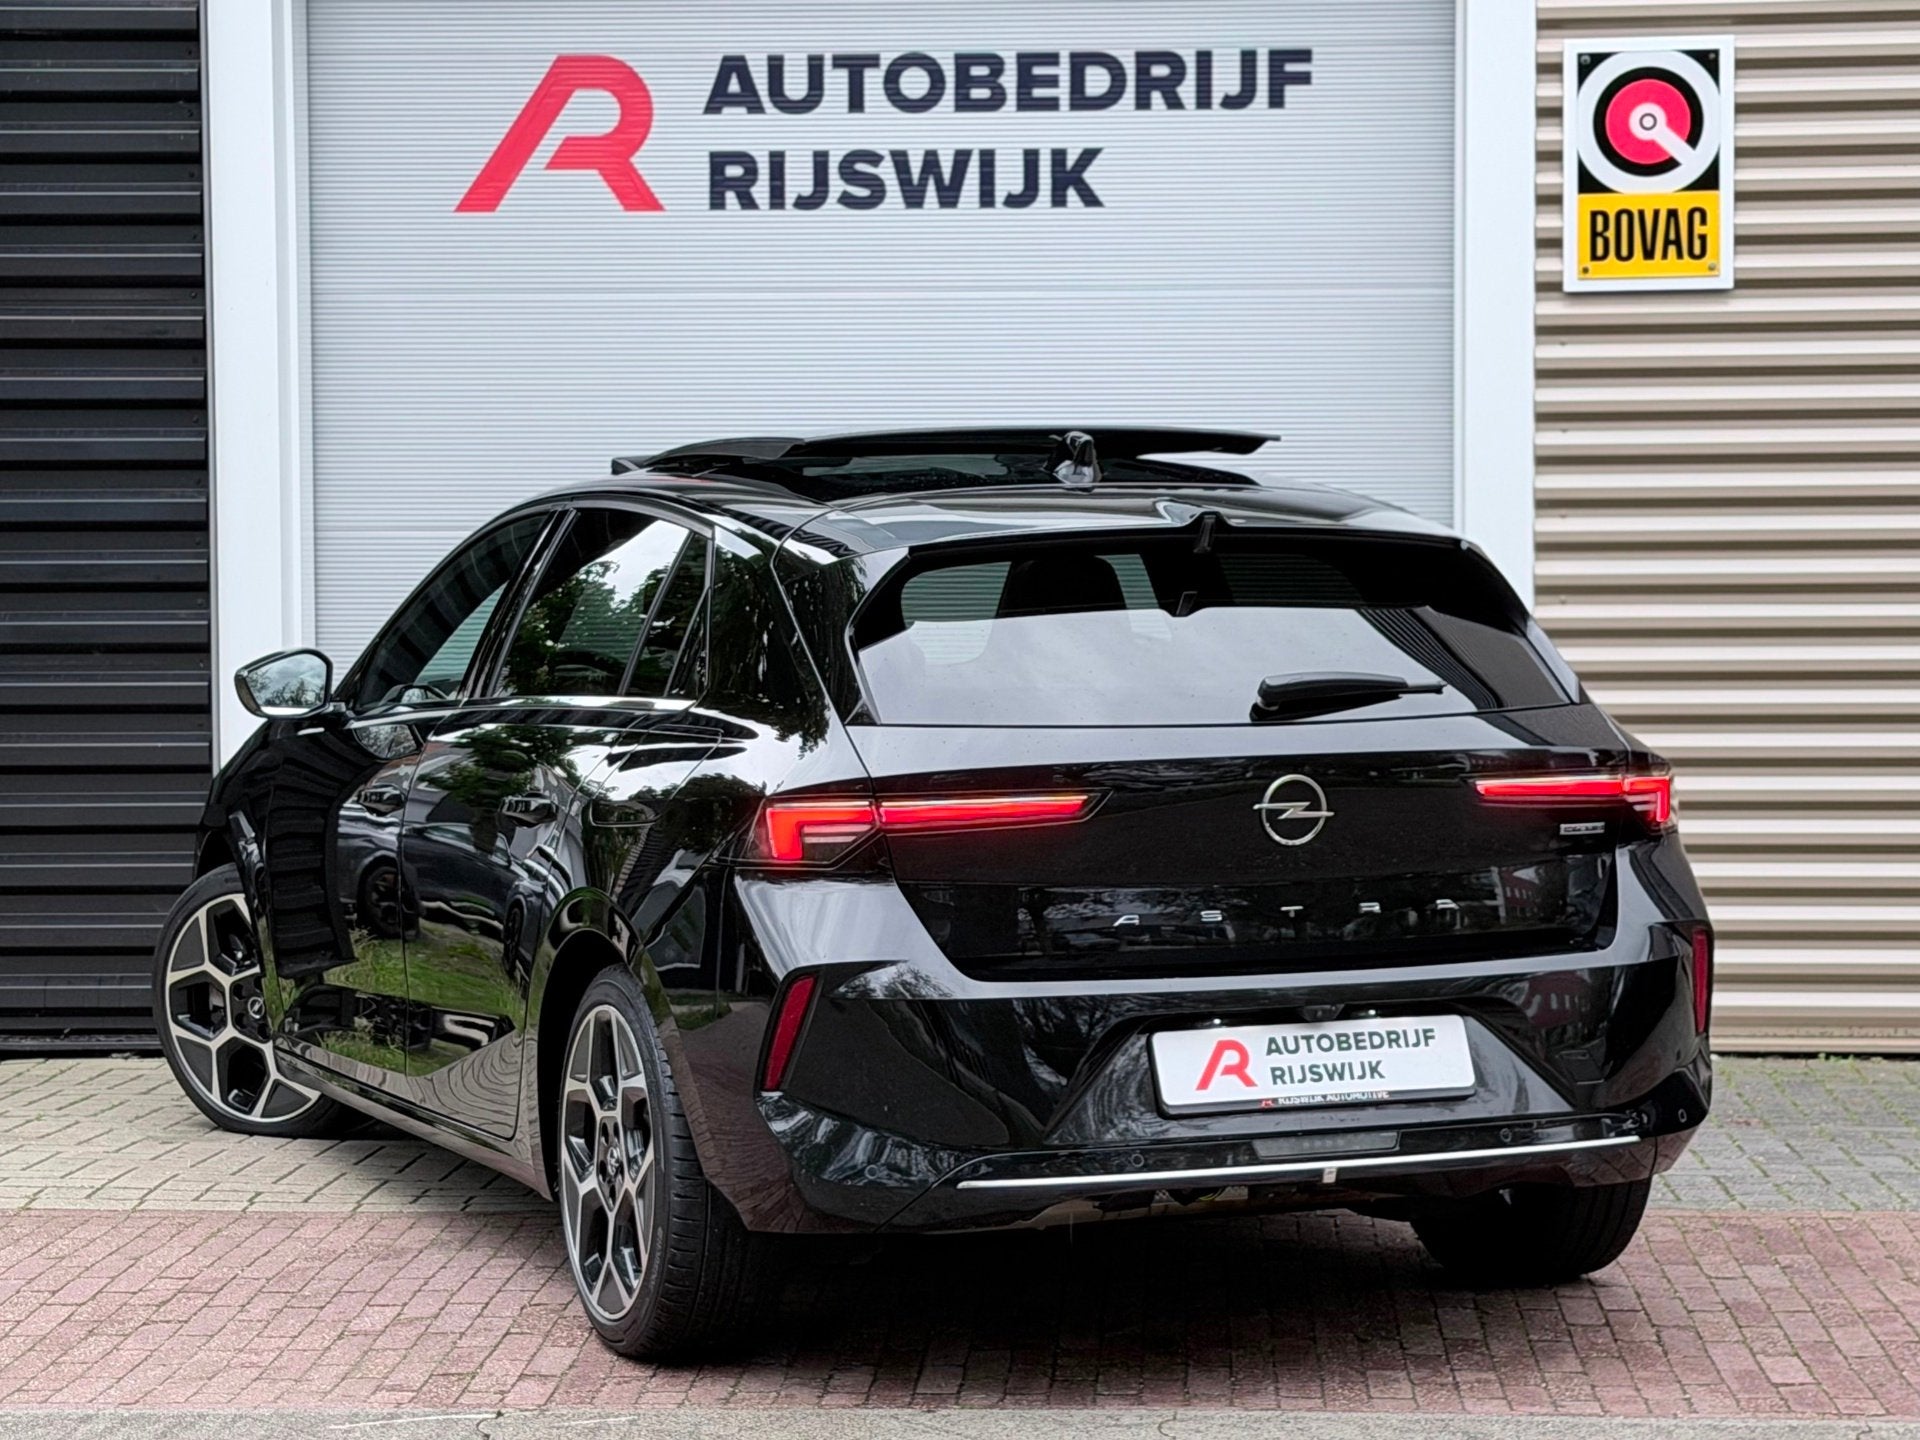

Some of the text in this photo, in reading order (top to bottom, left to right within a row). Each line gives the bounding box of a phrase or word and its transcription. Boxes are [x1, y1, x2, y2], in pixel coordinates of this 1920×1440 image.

[703, 48, 1313, 115] AUTOBEDRIJF
[709, 148, 1105, 211] RIJSWIJK
[1589, 206, 1708, 262] BOVAG
[1113, 898, 1459, 927] ASTRA
[1266, 1028, 1436, 1056] AUTOBEDRIJF
[1270, 1060, 1386, 1086] RIJSWIJK
